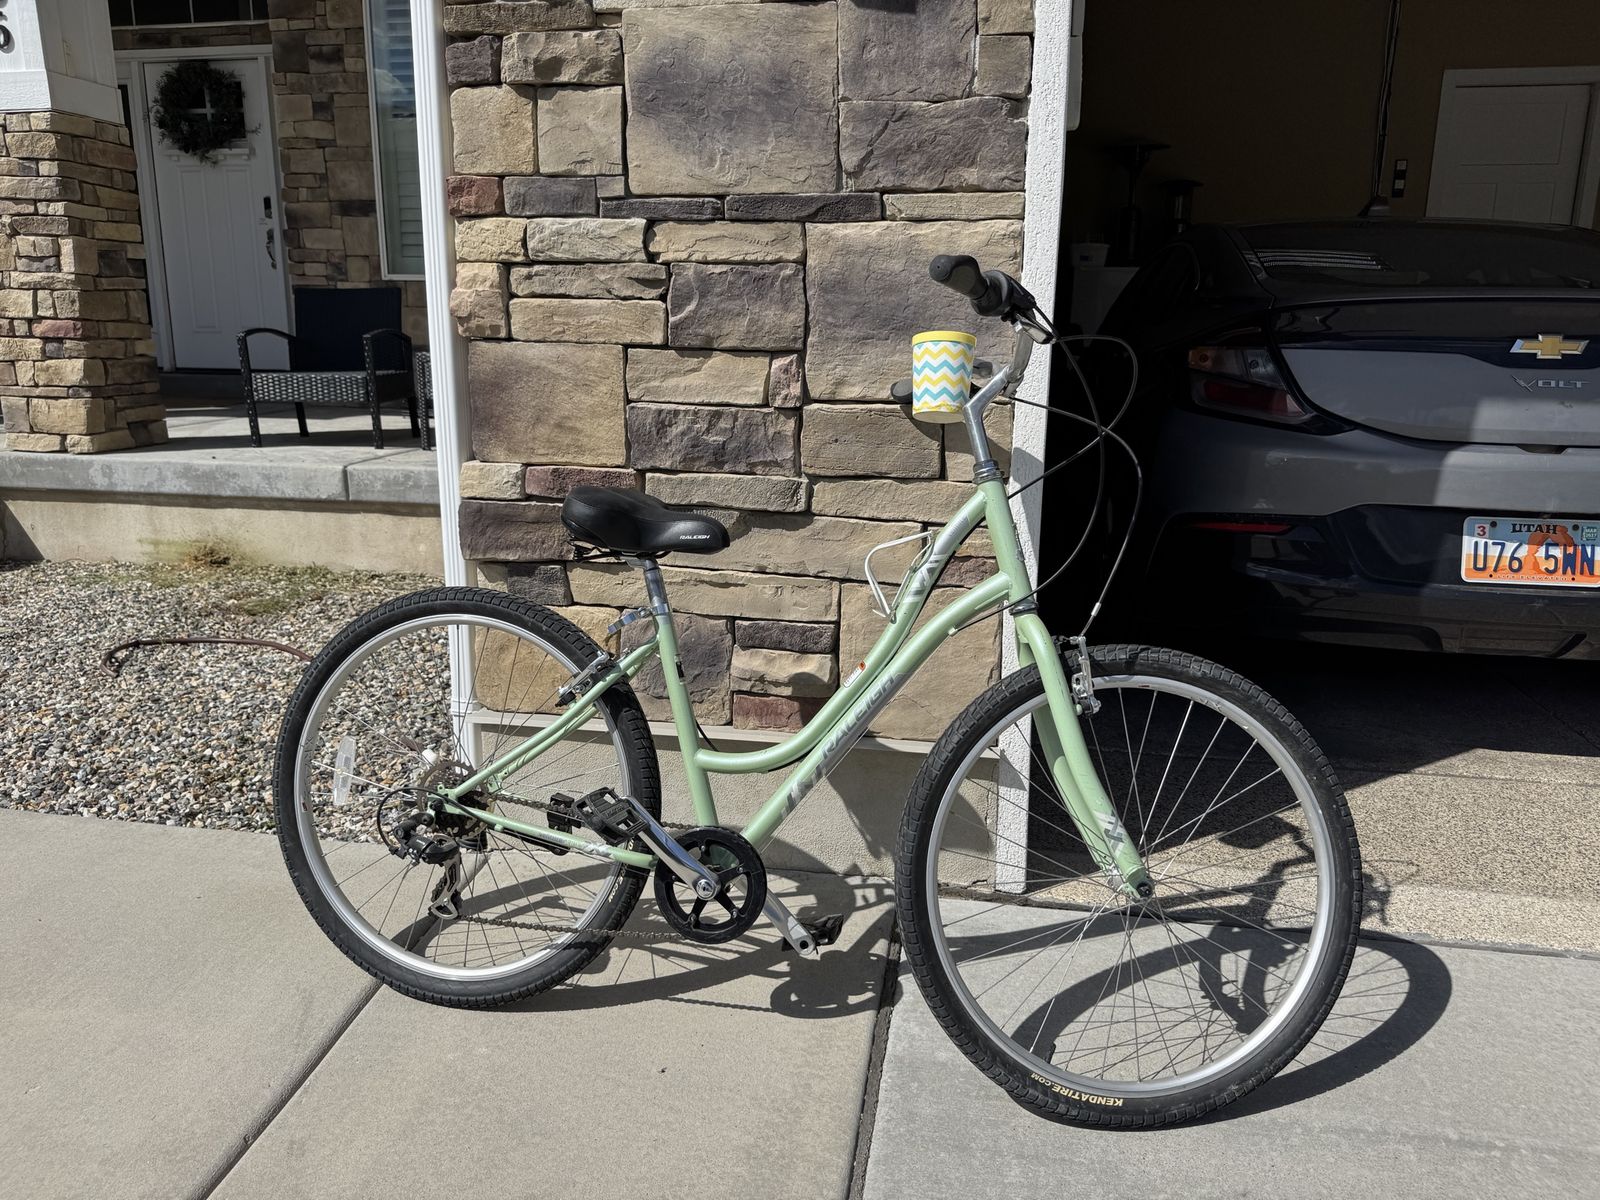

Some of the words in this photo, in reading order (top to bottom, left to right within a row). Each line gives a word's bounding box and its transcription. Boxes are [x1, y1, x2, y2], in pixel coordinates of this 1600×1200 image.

[1511, 375, 1592, 392] VOLT
[1476, 525, 1487, 537] 3
[1511, 523, 1558, 535] UTAH
[1472, 540, 1523, 573] U76
[1544, 542, 1595, 576] 5WN
[821, 673, 897, 761] RALEIGH
[1030, 1072, 1124, 1107] KENDATIRE.COM
